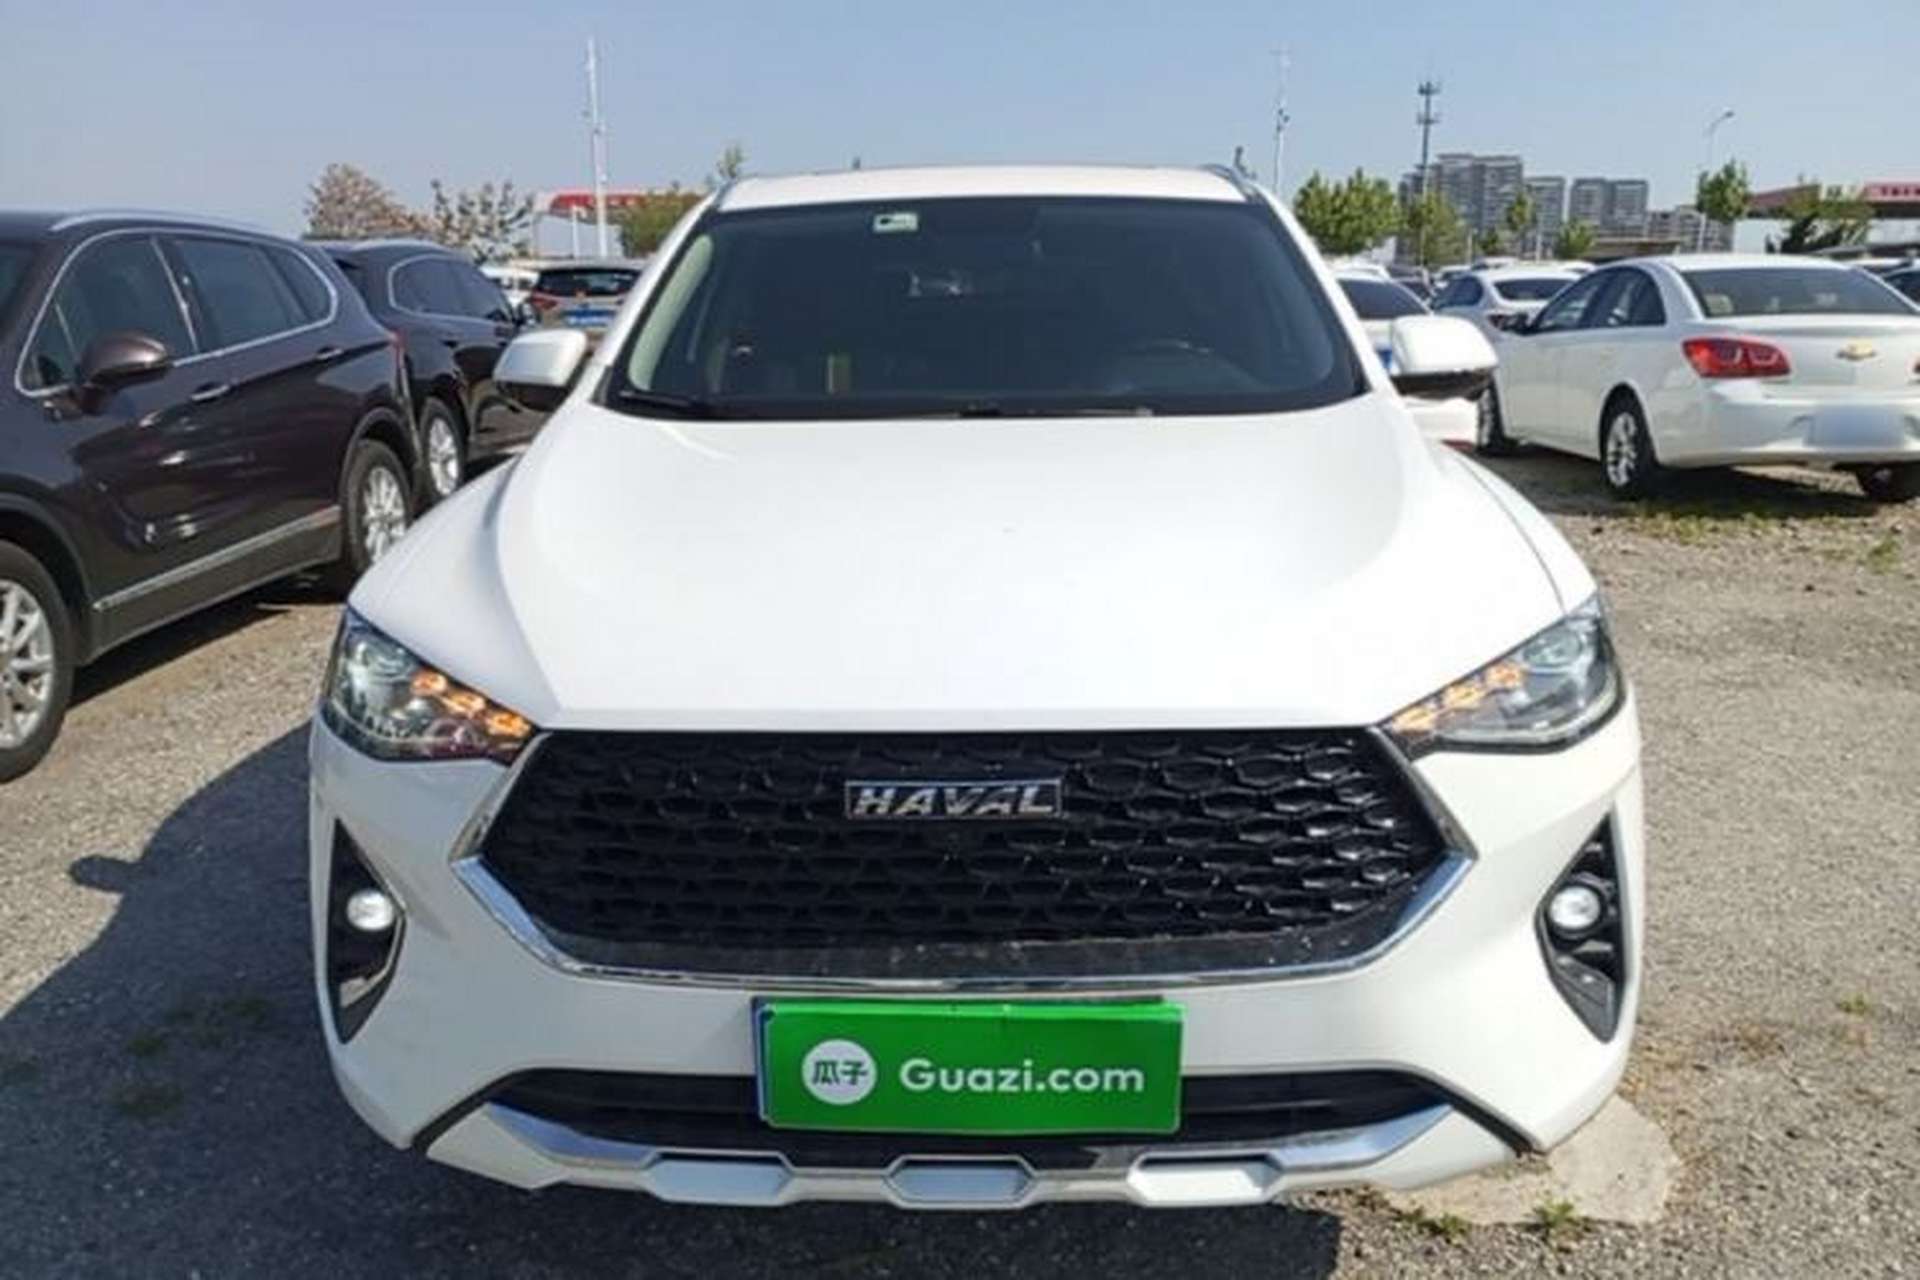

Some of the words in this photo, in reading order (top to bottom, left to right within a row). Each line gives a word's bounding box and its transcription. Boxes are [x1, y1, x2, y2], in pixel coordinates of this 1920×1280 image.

[852, 786, 1054, 815] HAVAL
[811, 1059, 869, 1086] 瓜子
[899, 1057, 1145, 1092] Guazi.com
